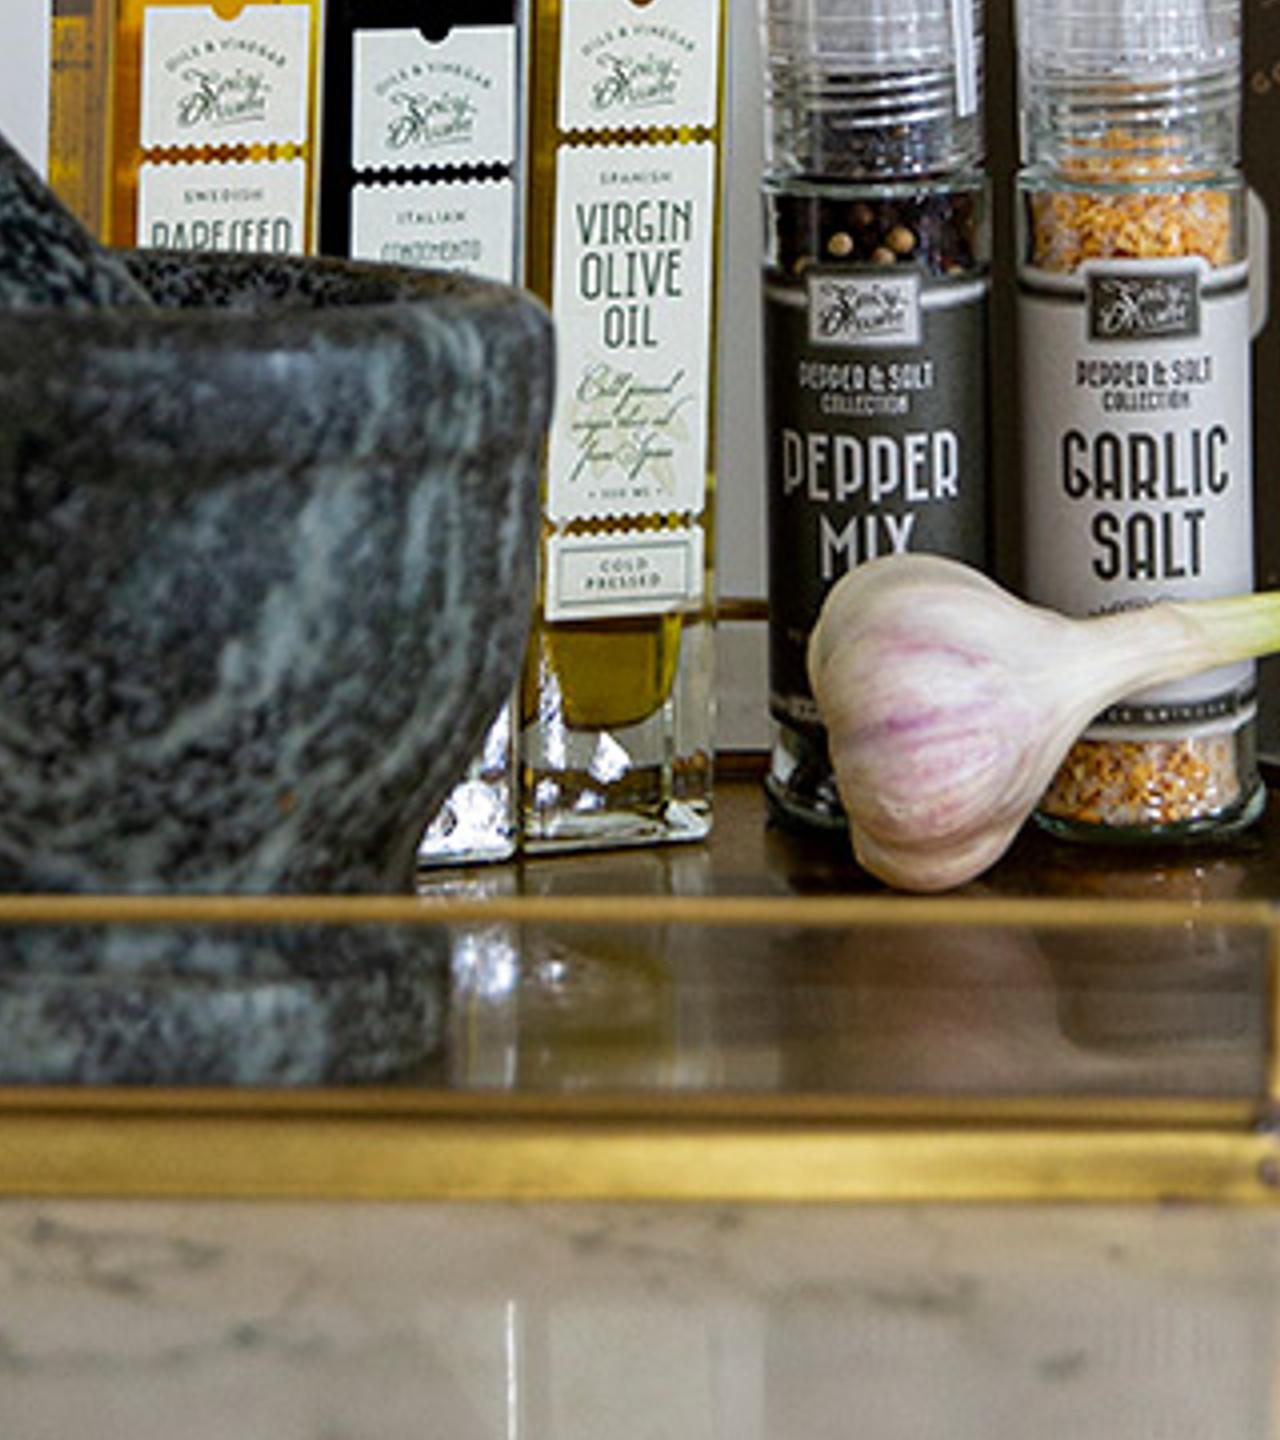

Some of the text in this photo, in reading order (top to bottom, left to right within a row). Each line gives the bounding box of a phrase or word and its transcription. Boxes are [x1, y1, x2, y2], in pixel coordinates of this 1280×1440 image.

[600, 170, 672, 186] SPANISH
[396, 211, 466, 225] ITALIAN
[575, 200, 693, 246] VIRGIN
[580, 248, 682, 301] OLIVE
[604, 304, 658, 350] OIL
[800, 361, 934, 390] PEPPER & SALT
[1076, 356, 1212, 388] PEPPER & SALT
[1102, 390, 1190, 412] COLLECTION
[783, 429, 959, 502] PEPPER
[1062, 424, 1229, 500] GARLIC
[820, 513, 914, 580] MIX
[1091, 510, 1205, 580] SALT
[585, 574, 661, 590] PRESSED
[600, 557, 648, 574] COLD
